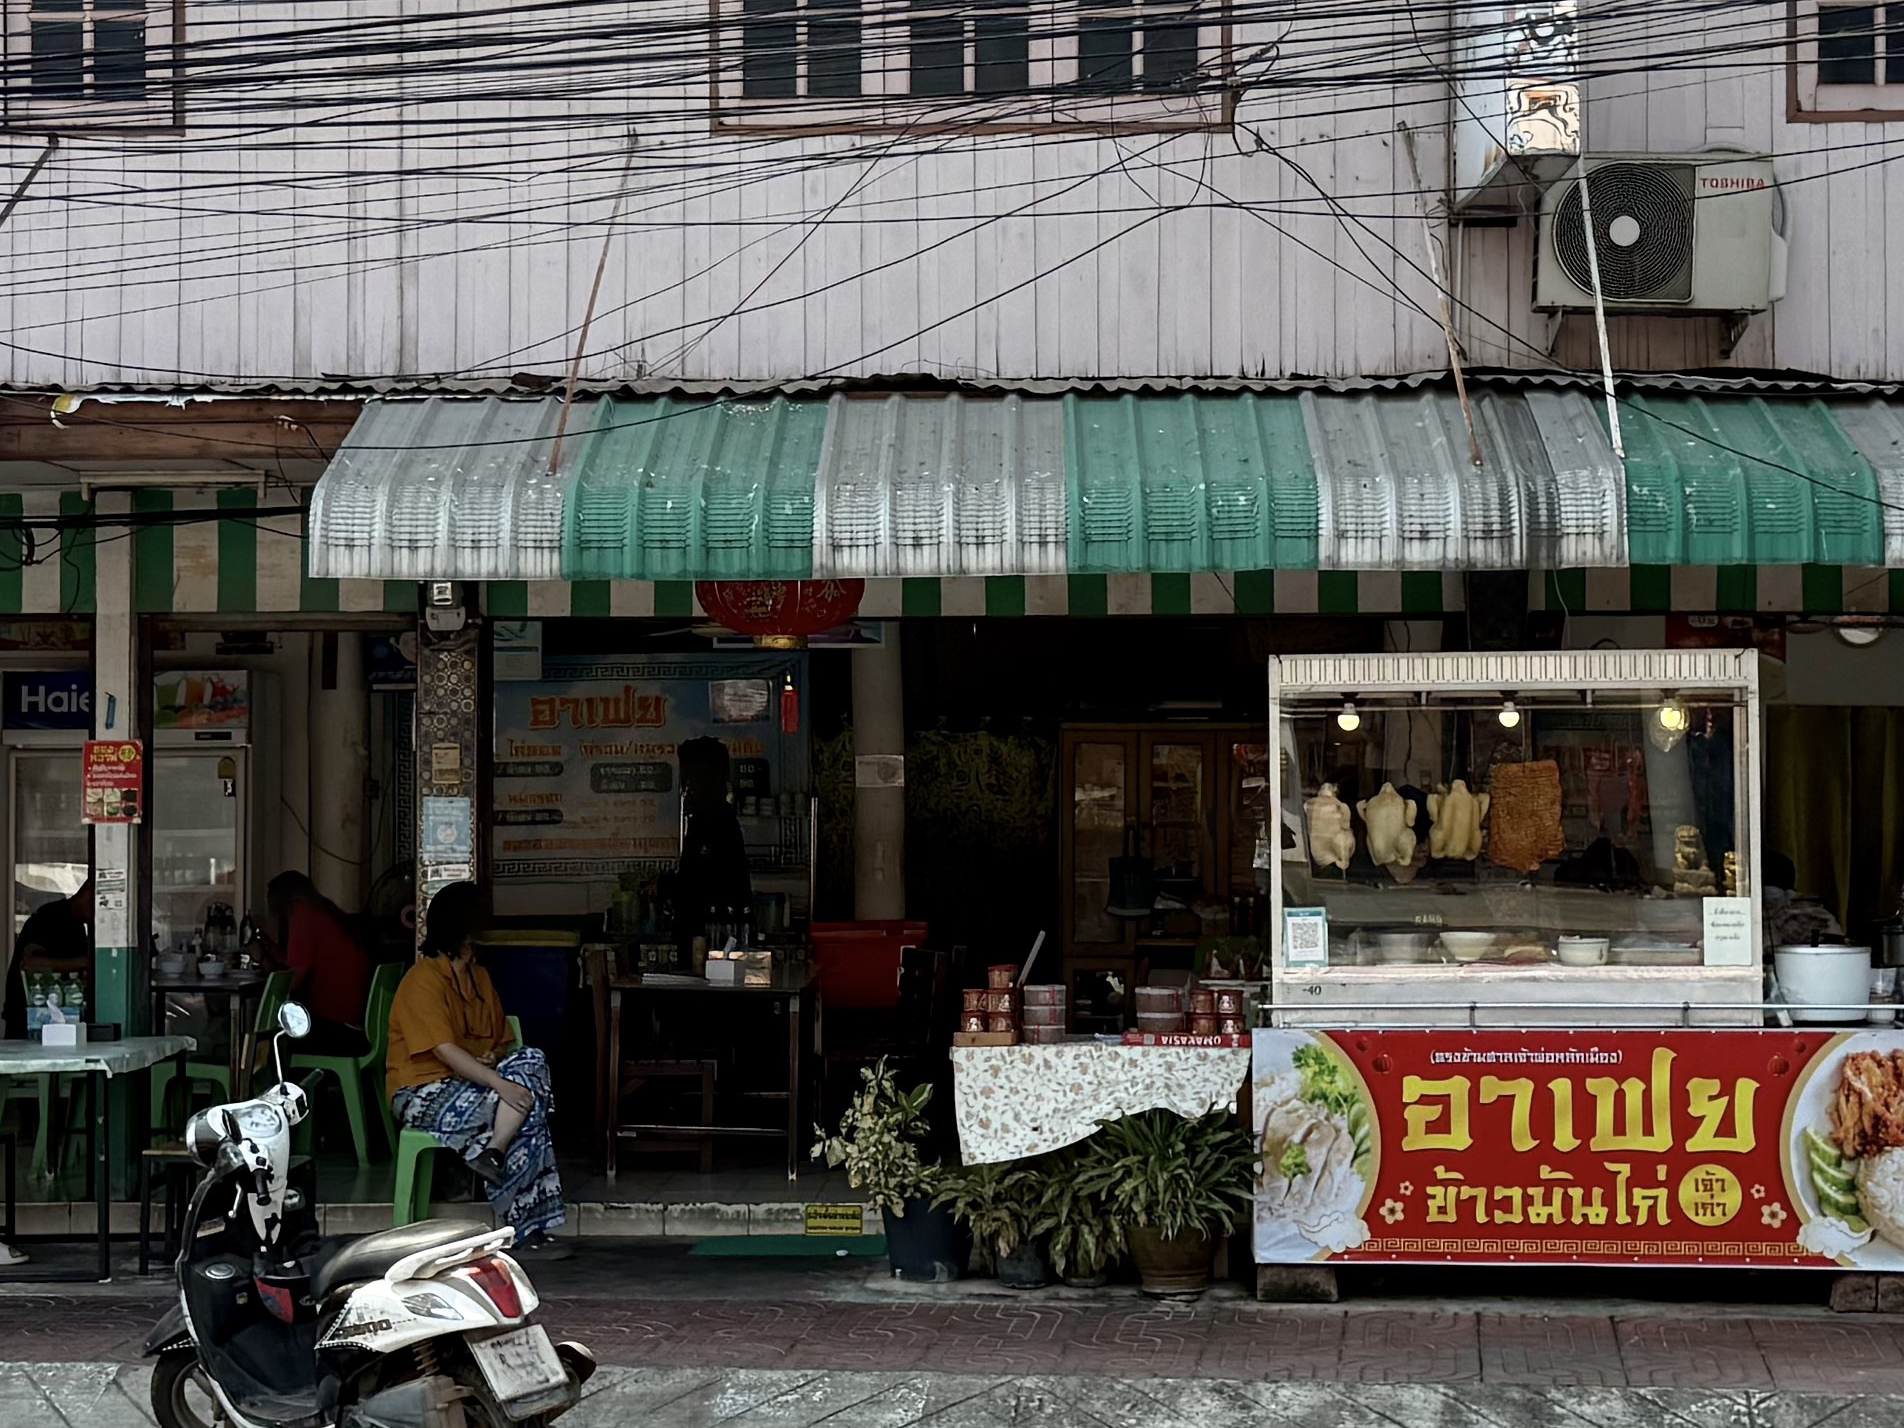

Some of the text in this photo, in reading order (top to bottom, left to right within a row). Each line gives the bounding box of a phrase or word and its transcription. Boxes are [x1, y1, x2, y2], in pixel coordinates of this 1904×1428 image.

[1700, 178, 1765, 193] TOSHIBA
[1401, 1047, 1760, 1154] อาเฟย
[1425, 1161, 1672, 1226] ข้าวมันไก่
[1694, 1171, 1727, 1194] เจ้า
[1693, 1194, 1727, 1218] เก่า
